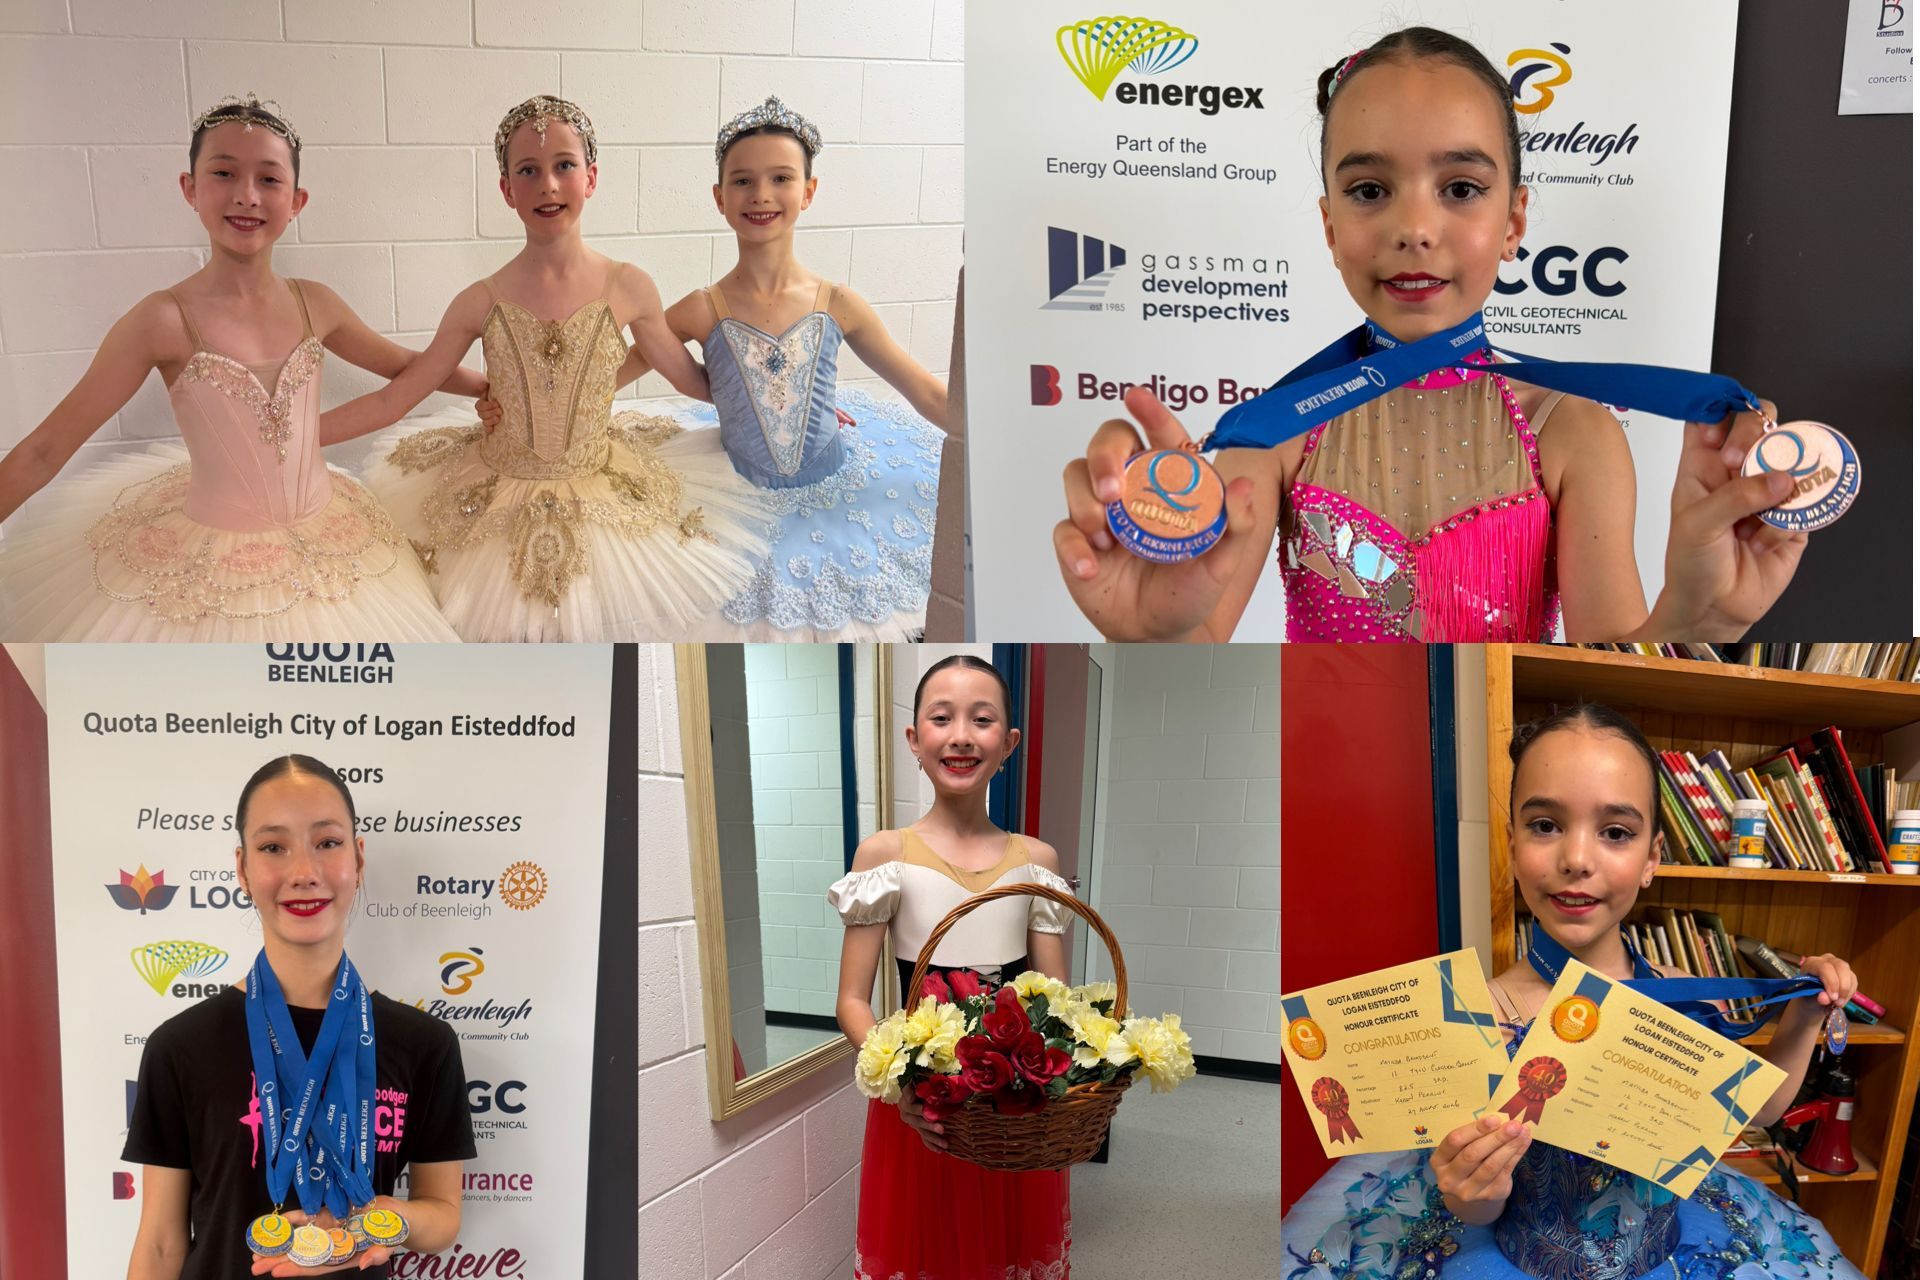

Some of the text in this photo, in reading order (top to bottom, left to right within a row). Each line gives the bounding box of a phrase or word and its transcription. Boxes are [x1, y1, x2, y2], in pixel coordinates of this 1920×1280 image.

[1885, 47, 1913, 55] Follow
[1868, 74, 1907, 84] concerts
[1115, 81, 1265, 116] energex
[1116, 134, 1207, 154] Part of the
[1519, 121, 1639, 166] eenleigh
[1046, 157, 1277, 184] Energy Queensland Group
[1520, 172, 1634, 187] nd Community Club
[1141, 253, 1289, 274] gassman
[1493, 246, 1630, 297] CGC
[1141, 275, 1288, 299] development
[1089, 303, 1126, 312] est 1985
[1142, 301, 1290, 323] perspectives
[1483, 306, 1628, 320] CIVIL GEOTECHNICAL
[1483, 322, 1582, 335] CONSULTANTS
[1294, 375, 1369, 415] QUOTA BEENLEIGH
[1790, 465, 1837, 499] OTA
[1805, 463, 1857, 521] BEENLEIGH
[1787, 492, 1854, 531] WE CHANGE LIVES
[1141, 529, 1219, 552] BEENLEIGH
[268, 664, 393, 684] BEENLEIGH
[83, 712, 576, 741] Quota Beenleigh City of Logan Eisteddfod
[334, 766, 384, 784] sors
[137, 808, 215, 831] Please
[394, 810, 522, 834] businesses
[189, 870, 236, 881] CITY OF
[416, 875, 496, 900] Rotary
[189, 885, 254, 910] LOG
[366, 903, 492, 921] Club of Beenleigh
[1326, 978, 1420, 1006] QUOTA BEENLEIGH CITY OF
[429, 998, 533, 1028] Beenleigh
[1342, 994, 1411, 1016] LOGAN EISTEDDFOD
[1344, 1010, 1420, 1032] HONOUR CERTIFICATE
[1628, 1006, 1725, 1060] QUOTA BEENLEIGH CITY OF
[461, 1031, 530, 1042] Community Club
[1343, 1027, 1442, 1054] CONGRATULATIONS
[1634, 1024, 1706, 1063] LOGAN EISTEDDFOD
[1622, 1035, 1700, 1077] HONOUR CERTIFICATE
[1532, 1069, 1556, 1086] 40
[1601, 1048, 1702, 1100] CONGRATULATIONS
[465, 1080, 528, 1114] GC
[292, 1117, 303, 1137] QUOTA
[361, 1100, 369, 1140] BEENLEIGH
[493, 1194, 503, 1204] by
[503, 1194, 533, 1202] dancers
